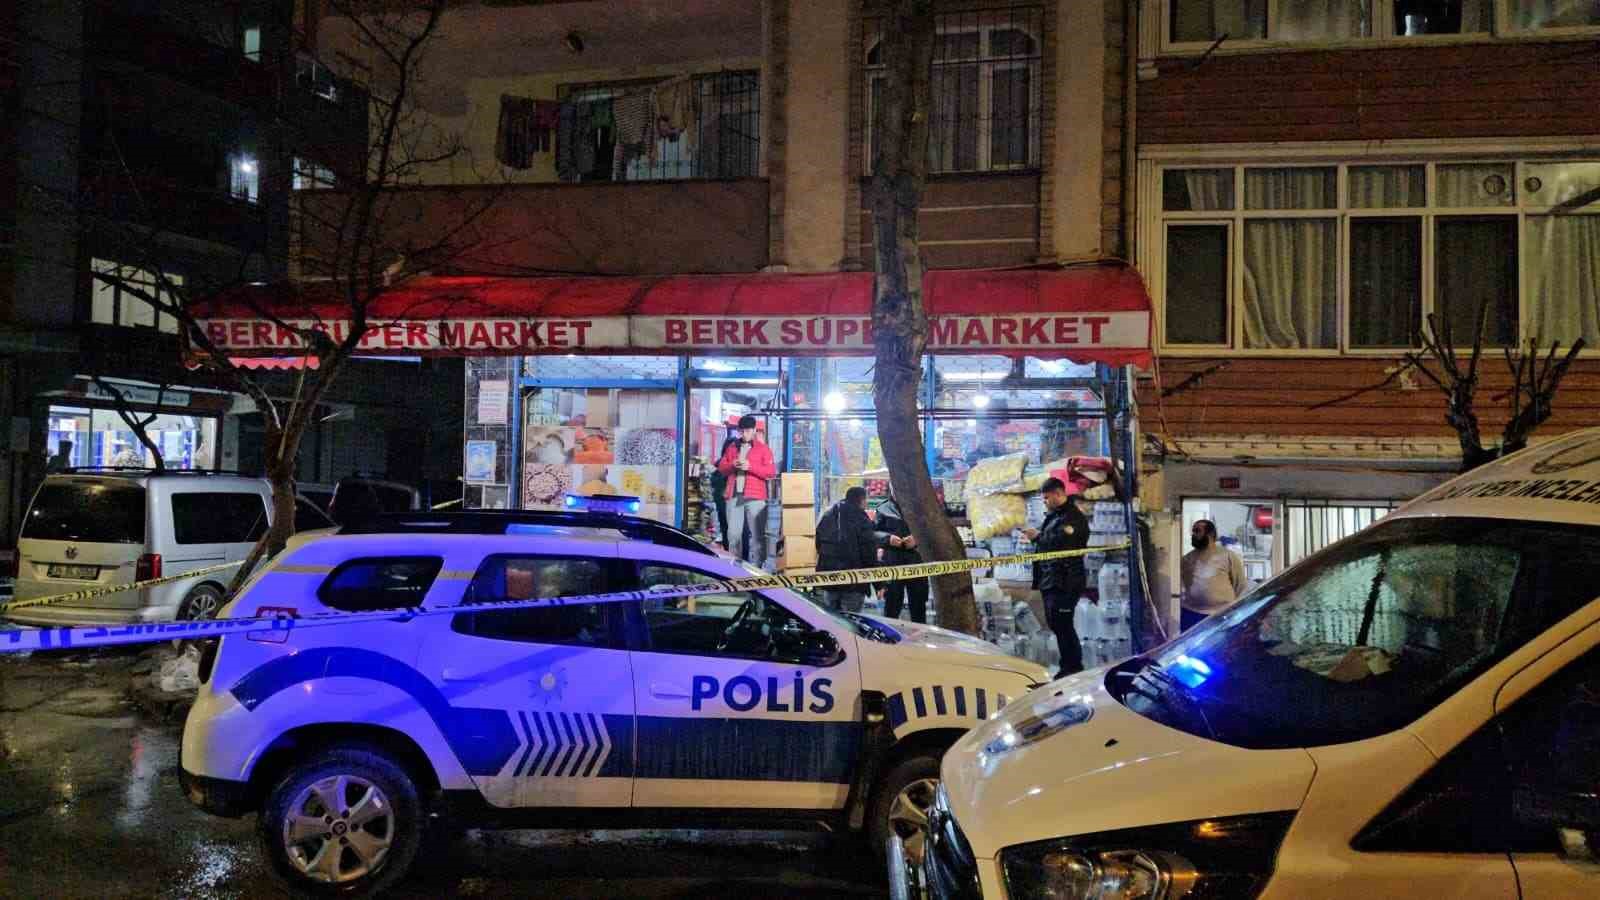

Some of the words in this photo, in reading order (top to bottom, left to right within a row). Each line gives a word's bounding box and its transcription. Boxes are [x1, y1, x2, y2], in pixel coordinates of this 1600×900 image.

[208, 321, 298, 346] BERK
[438, 320, 592, 346] MARKET
[665, 320, 770, 345] BERK
[780, 316, 874, 345] SÜPE
[926, 317, 1109, 344] MARKET
[692, 671, 834, 714] POLİS
